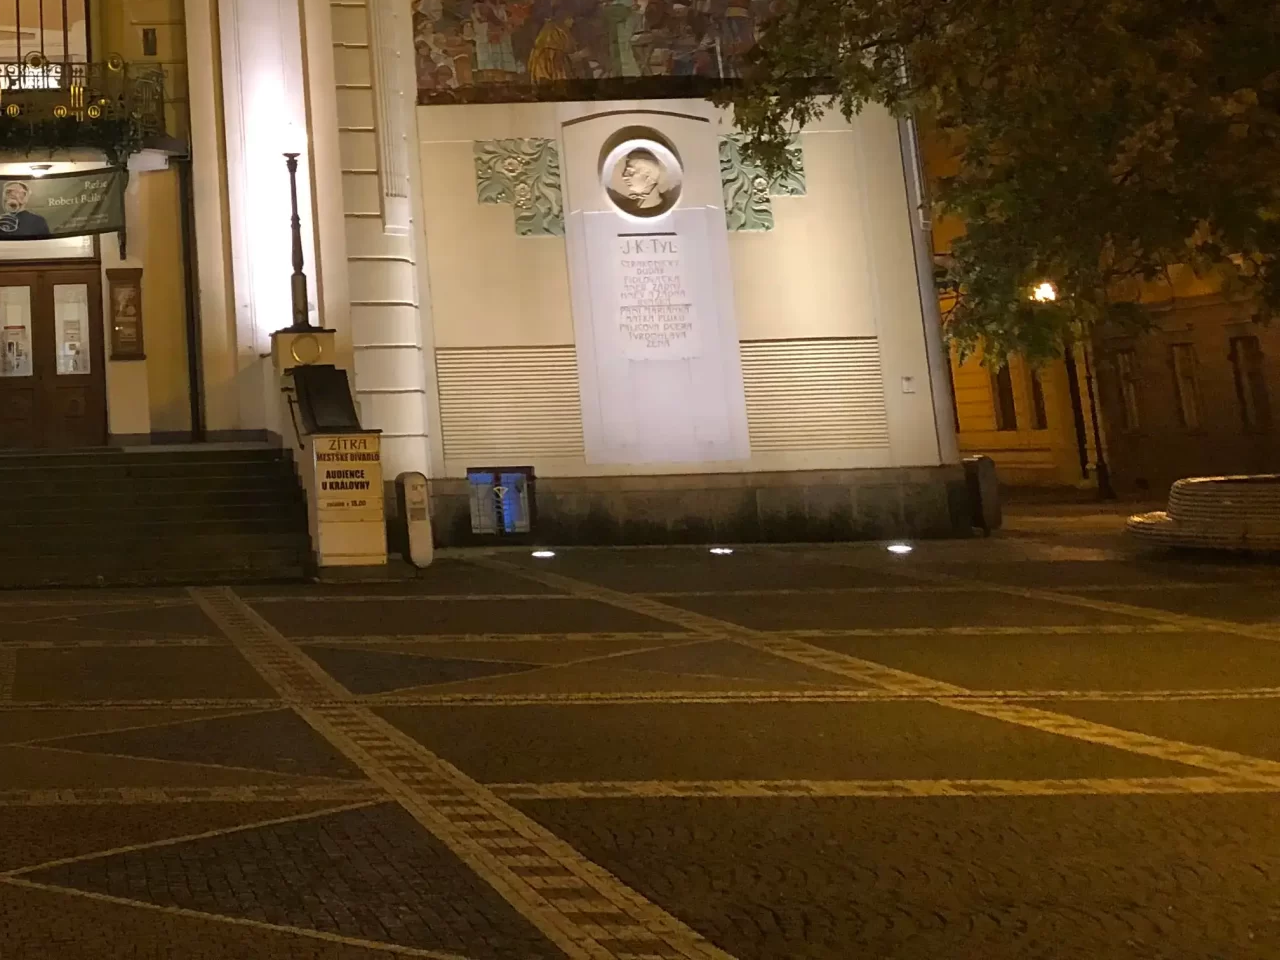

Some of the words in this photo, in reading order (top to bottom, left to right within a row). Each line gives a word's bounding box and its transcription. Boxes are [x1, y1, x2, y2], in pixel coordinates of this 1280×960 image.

[329, 437, 367, 450] ZÍTRA
[326, 469, 365, 479] AUDIENCE
[322, 482, 327, 490] U
